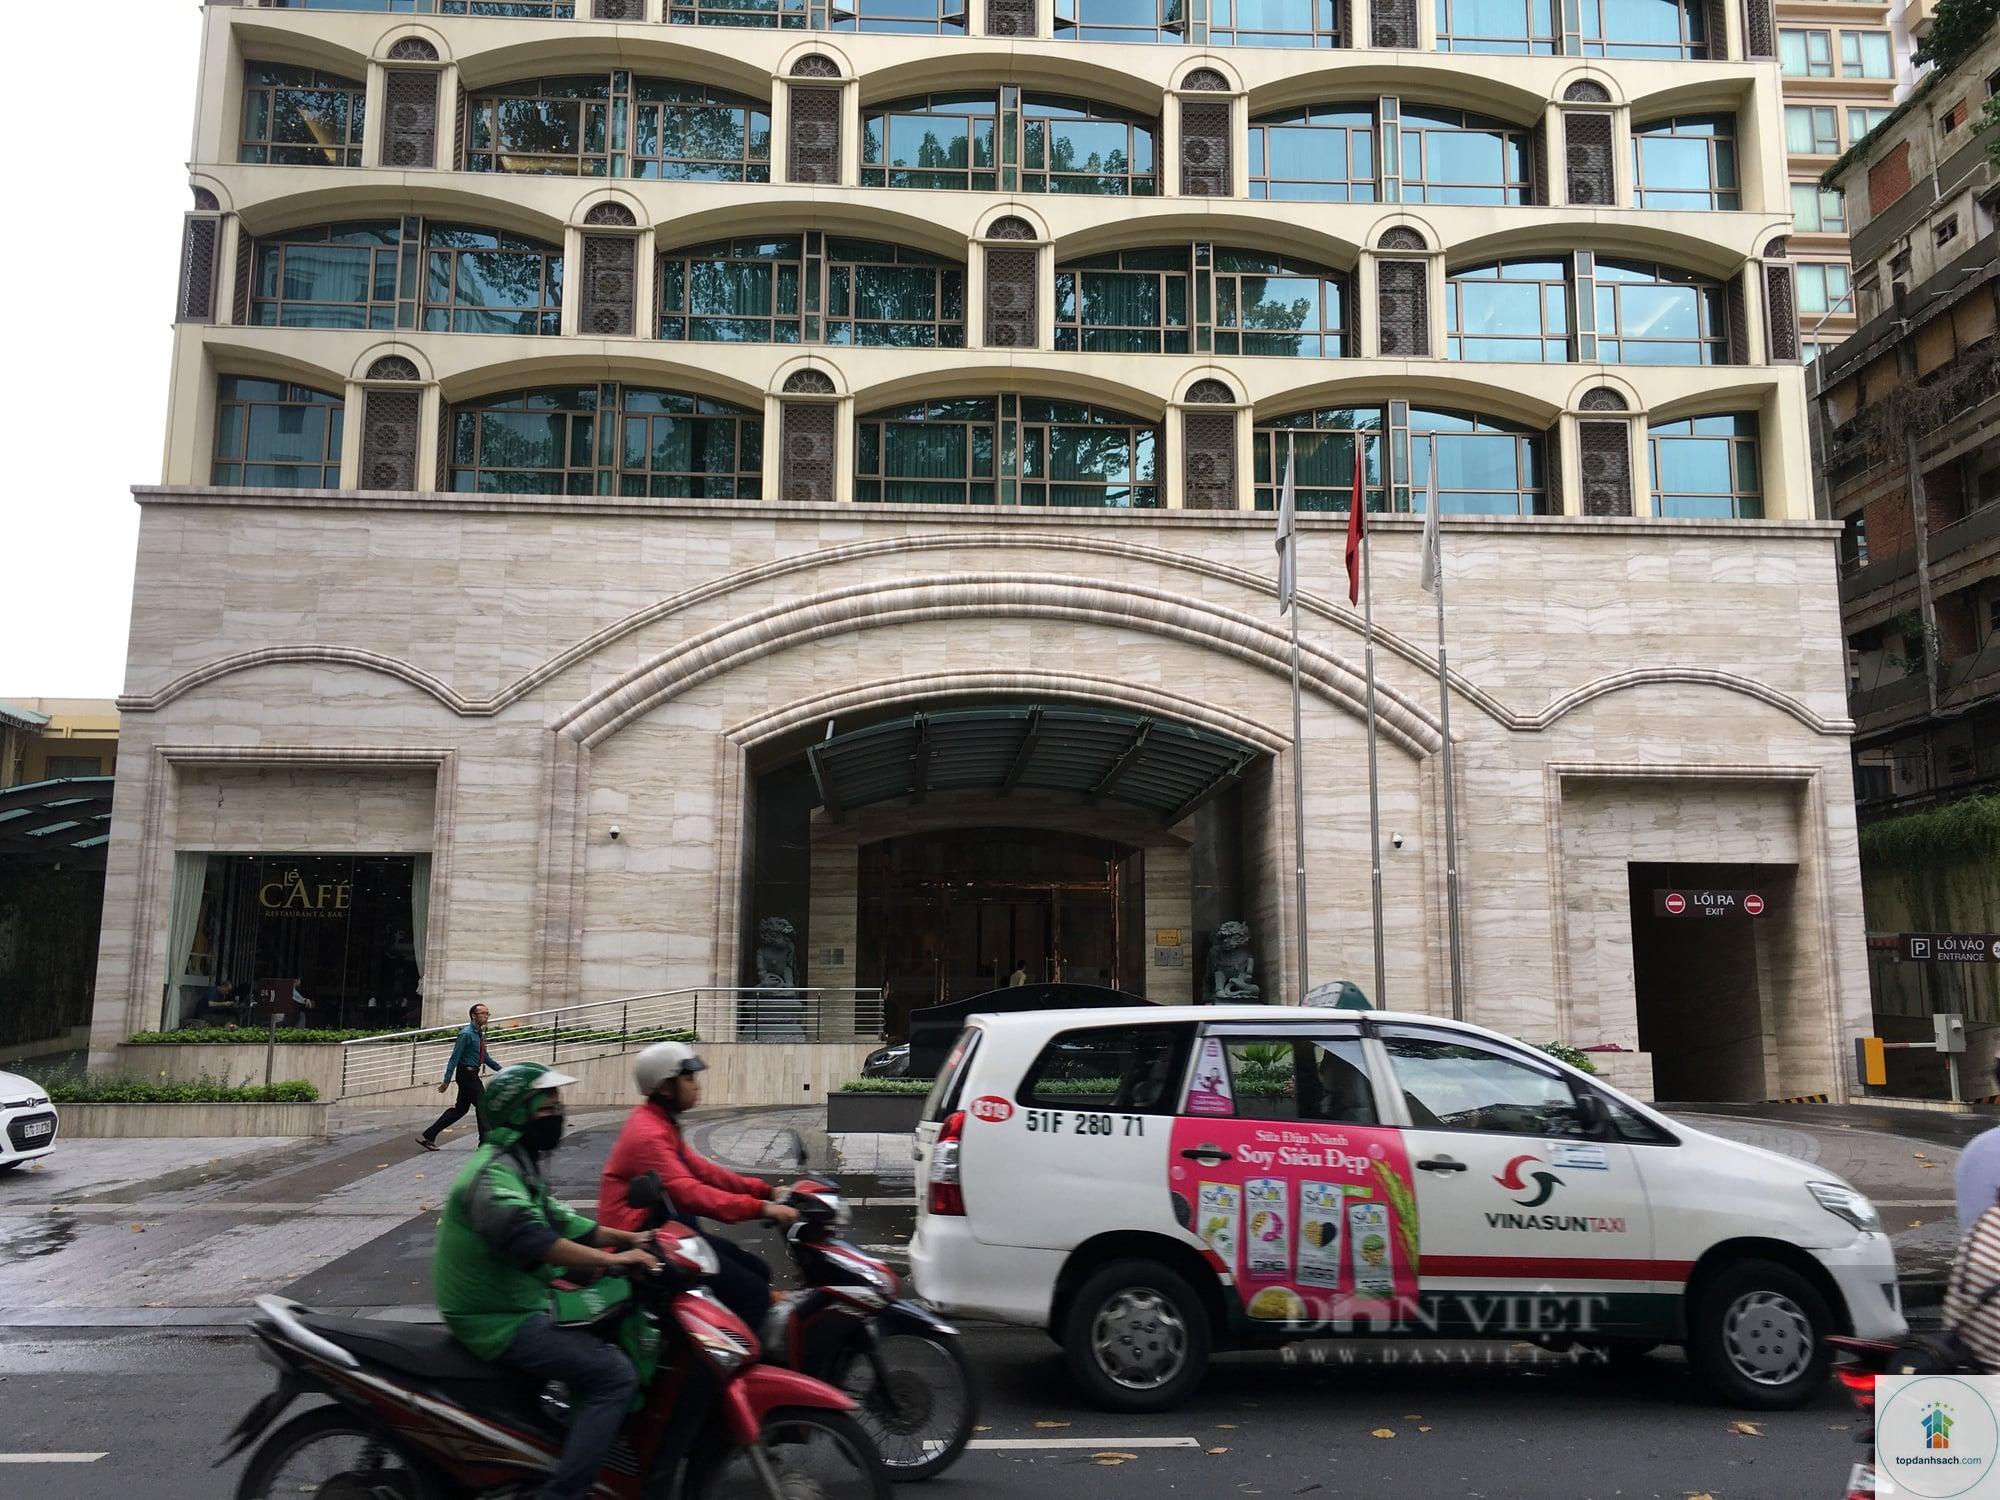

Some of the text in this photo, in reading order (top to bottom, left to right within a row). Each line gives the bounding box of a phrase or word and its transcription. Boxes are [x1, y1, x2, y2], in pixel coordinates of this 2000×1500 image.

[284, 871, 300, 887] Le
[259, 878, 352, 909] CAFÉ
[1694, 891, 1735, 906] LỐI RA
[265, 910, 318, 918] RESTAURANT
[1705, 907, 1726, 916] EXIT
[1915, 942, 1926, 955] P
[1937, 936, 1985, 951] LỐI VÀO
[1937, 952, 1985, 961] ENTRANCE
[1026, 1110, 1145, 1137] 51F 280 71
[1237, 1144, 1370, 1176] Soy Siêu Đẹp
